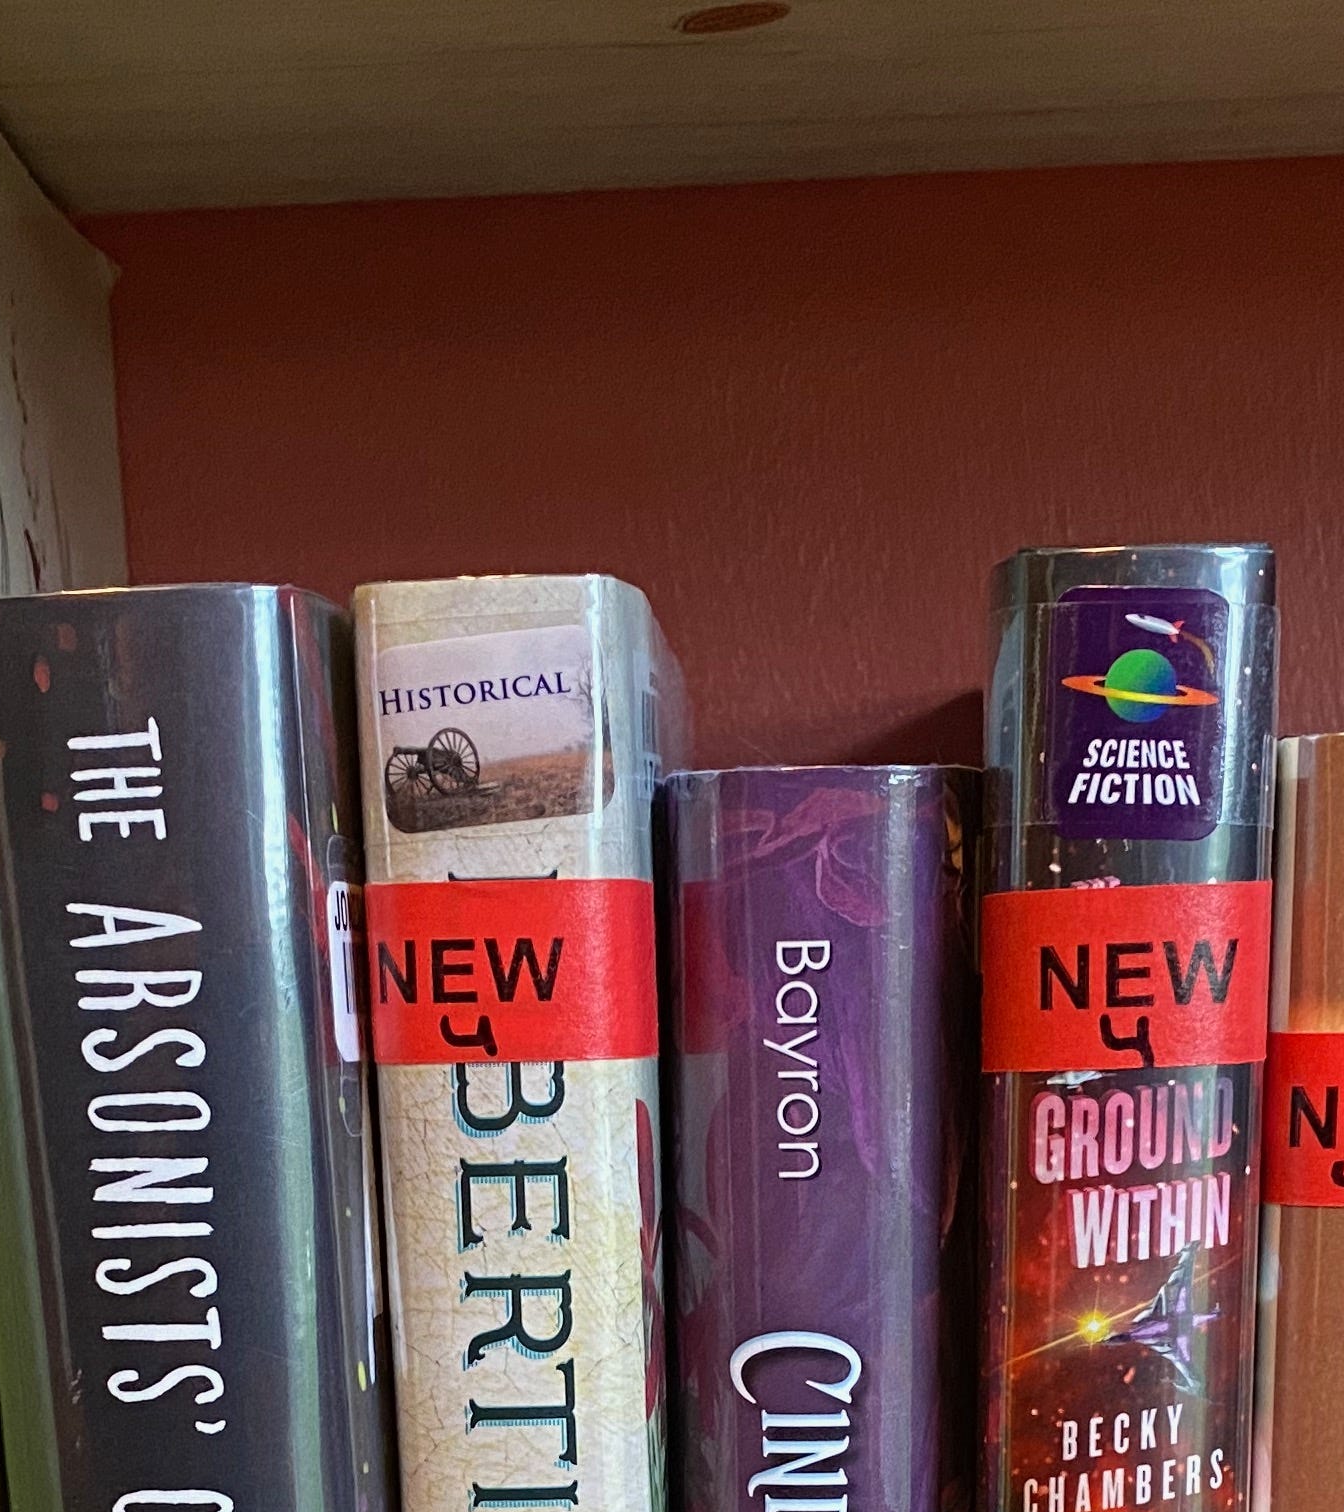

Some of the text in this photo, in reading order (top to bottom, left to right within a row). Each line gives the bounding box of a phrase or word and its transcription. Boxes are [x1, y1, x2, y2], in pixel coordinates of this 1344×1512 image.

[66, 716, 168, 842] THE
[1067, 772, 1201, 806] FICTION
[1082, 738, 1191, 770] SCIENCE
[377, 936, 565, 1005] NEW
[1039, 937, 1240, 1012] NEW
[762, 939, 831, 1179] Bayron
[1028, 1076, 1235, 1185] GROUND
[1064, 1171, 1232, 1270] WITHIN
[1061, 1402, 1184, 1462] BECKY
